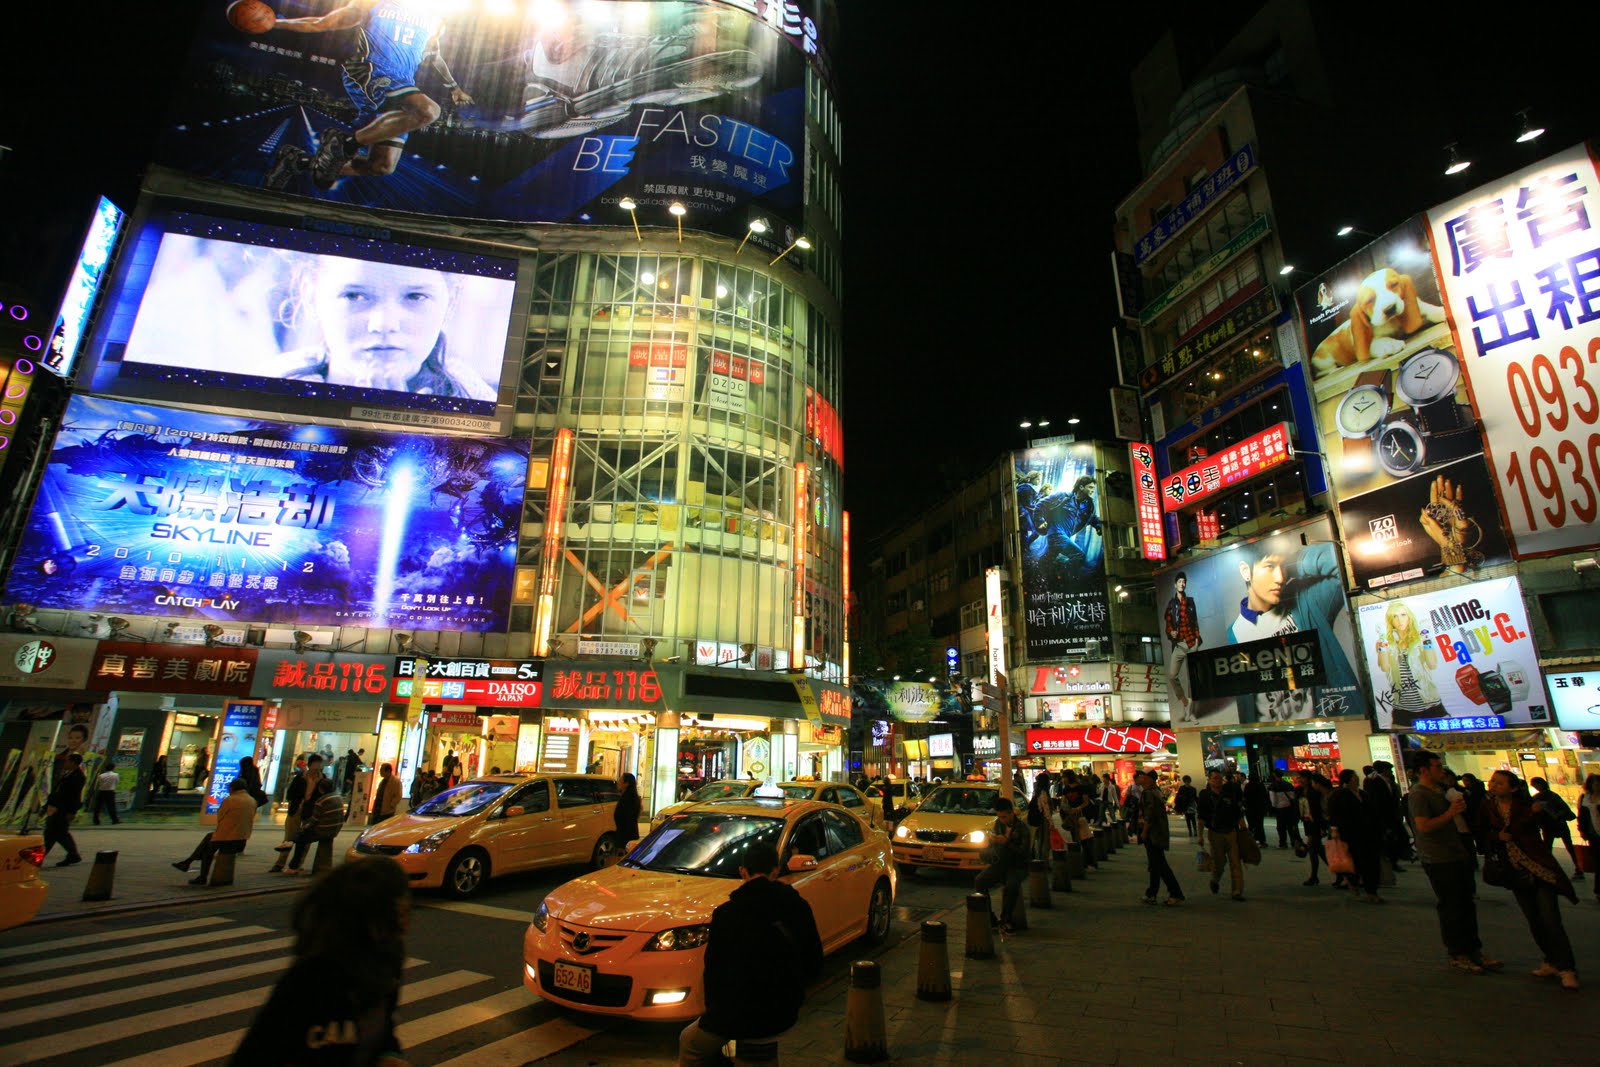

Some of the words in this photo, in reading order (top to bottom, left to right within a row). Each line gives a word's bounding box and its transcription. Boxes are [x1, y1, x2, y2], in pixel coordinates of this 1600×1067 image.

[393, 25, 415, 45] 12
[572, 136, 634, 173] BE
[634, 108, 793, 177] FASTER
[689, 154, 767, 189] 我變魔速
[1444, 173, 1592, 277] 廣告
[1466, 247, 1600, 357] 出租
[96, 468, 338, 531] 天際浩劫
[150, 522, 273, 548] SKYLINE
[154, 594, 240, 610] CATCHPLAY
[1027, 600, 1106, 627] 哈利波特
[1435, 612, 1527, 665] Baby-G.
[97, 653, 251, 683] 真善美劇院
[272, 659, 386, 693] 誠品116
[487, 682, 537, 696] DAISO
[496, 694, 524, 702] JAPAN
[551, 669, 662, 703] 誠品116
[1066, 683, 1083, 691] hair
